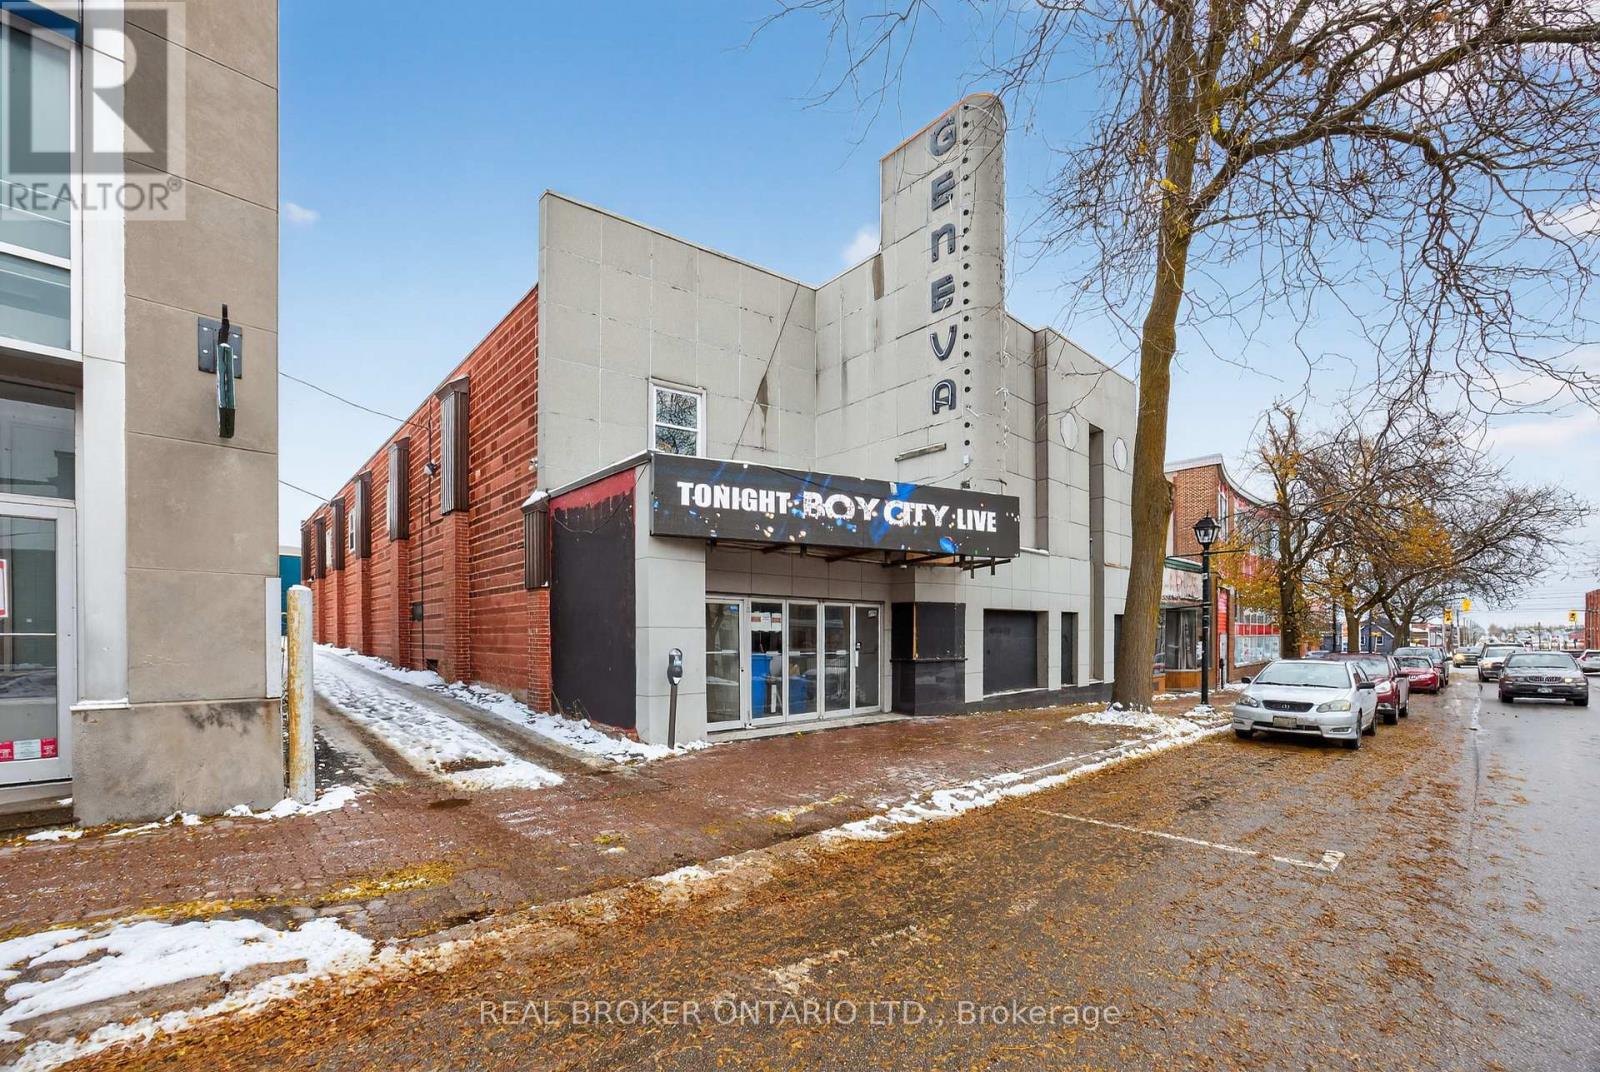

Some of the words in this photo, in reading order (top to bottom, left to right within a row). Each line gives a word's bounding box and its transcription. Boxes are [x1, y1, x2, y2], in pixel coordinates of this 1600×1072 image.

[677, 481, 791, 514] TONIGHT
[803, 491, 880, 521] BOY
[883, 500, 950, 527] CITY
[957, 508, 997, 533] LIVE
